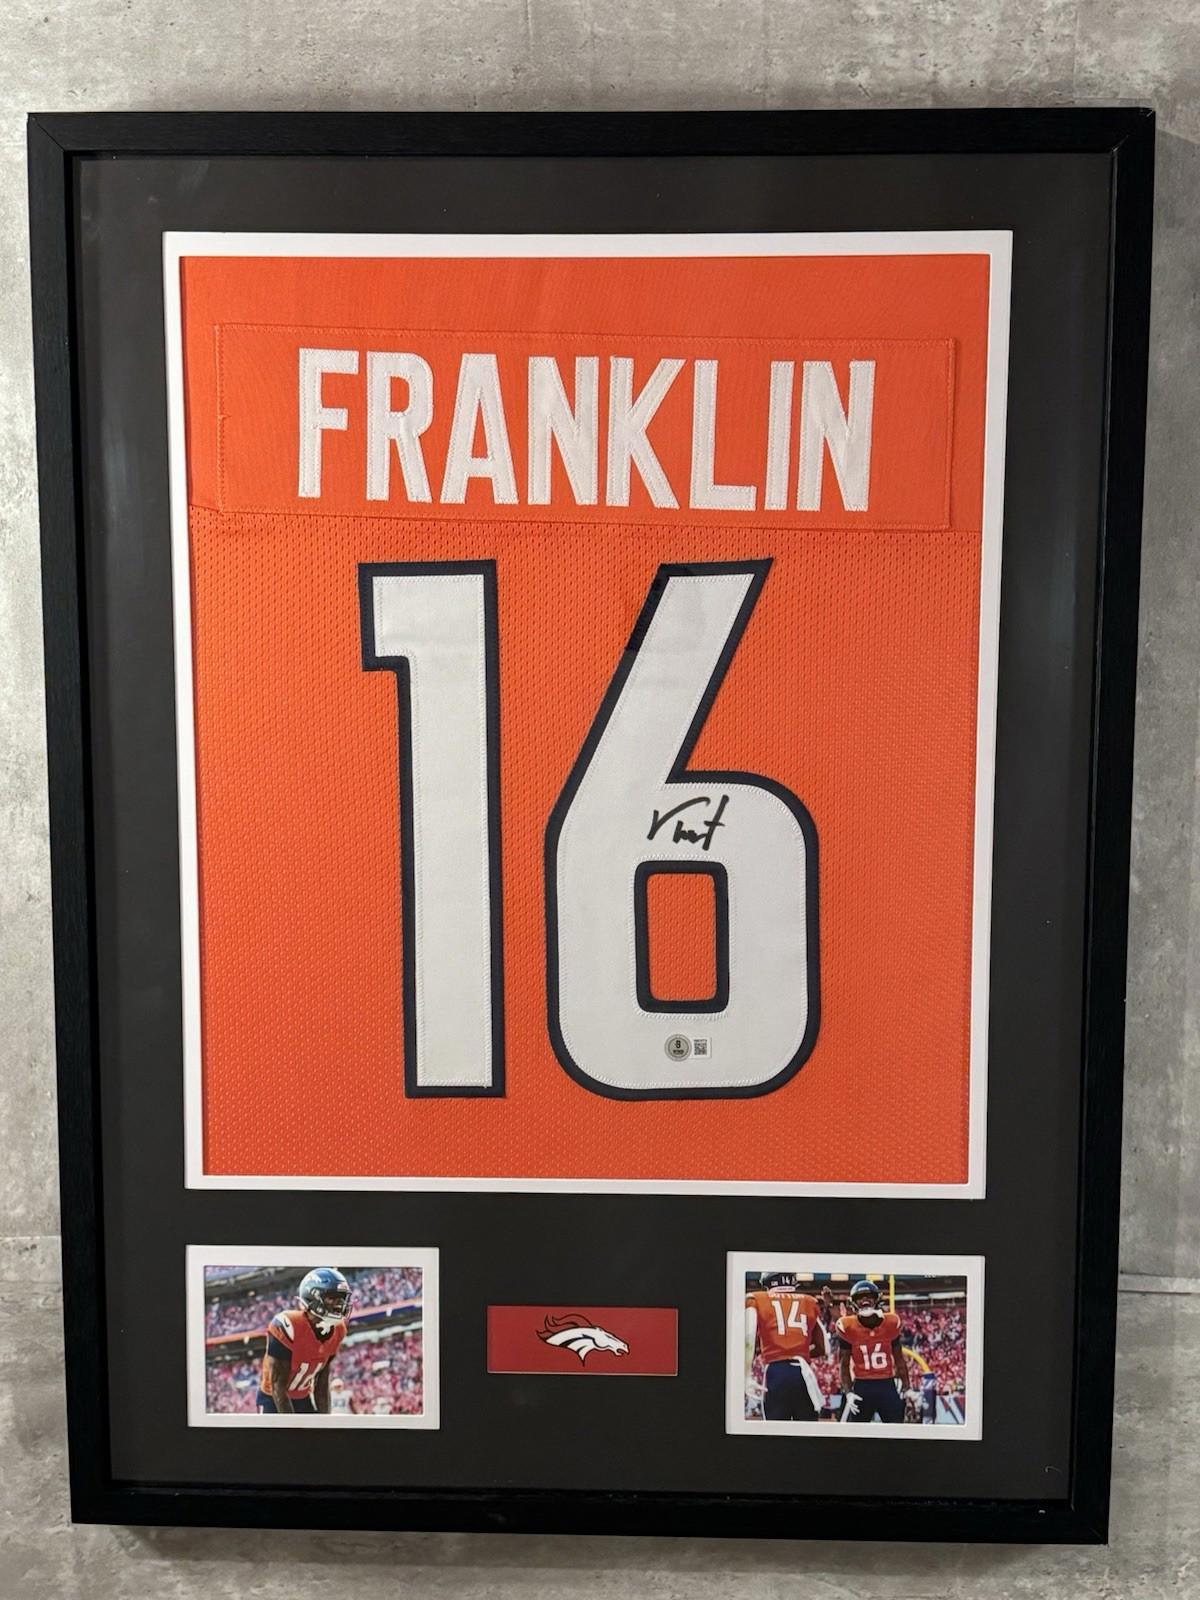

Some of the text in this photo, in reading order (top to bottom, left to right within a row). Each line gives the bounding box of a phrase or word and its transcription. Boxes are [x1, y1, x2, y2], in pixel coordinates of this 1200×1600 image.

[298, 347, 876, 513] FRANKLIN
[357, 557, 822, 1101] 16
[771, 1300, 808, 1337] 14
[860, 1343, 888, 1371] 16
